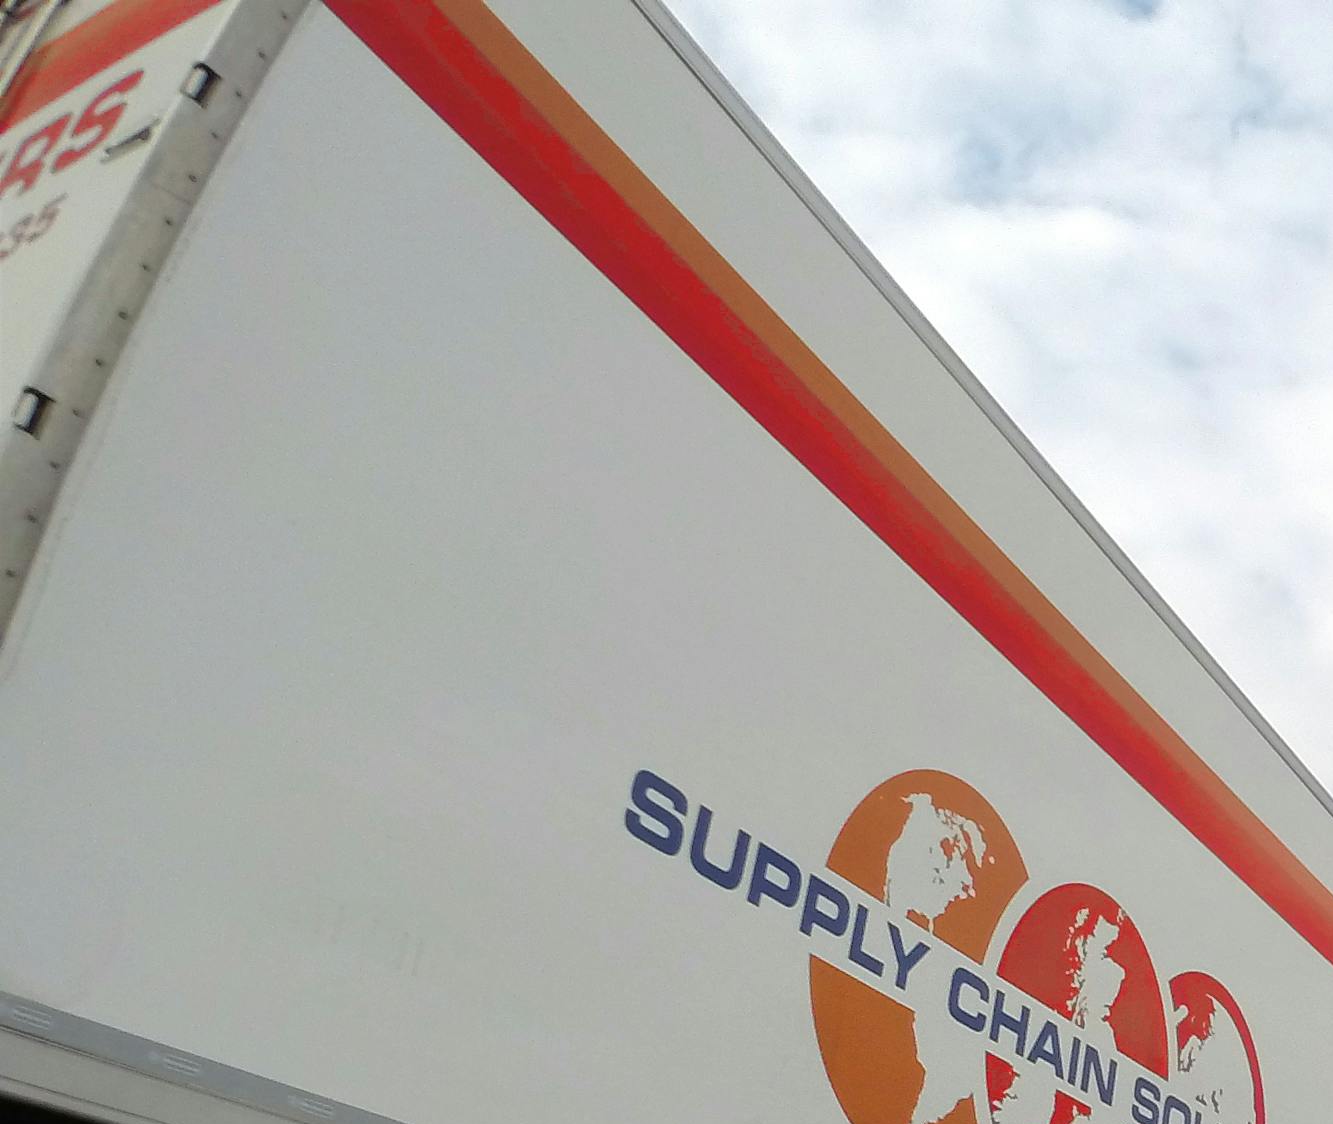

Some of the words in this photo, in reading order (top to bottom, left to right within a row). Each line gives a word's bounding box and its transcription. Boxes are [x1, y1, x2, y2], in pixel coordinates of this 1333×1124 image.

[0, 69, 145, 199] RS
[625, 768, 930, 991] SUPPLY
[948, 967, 1118, 1106] CHAIN
